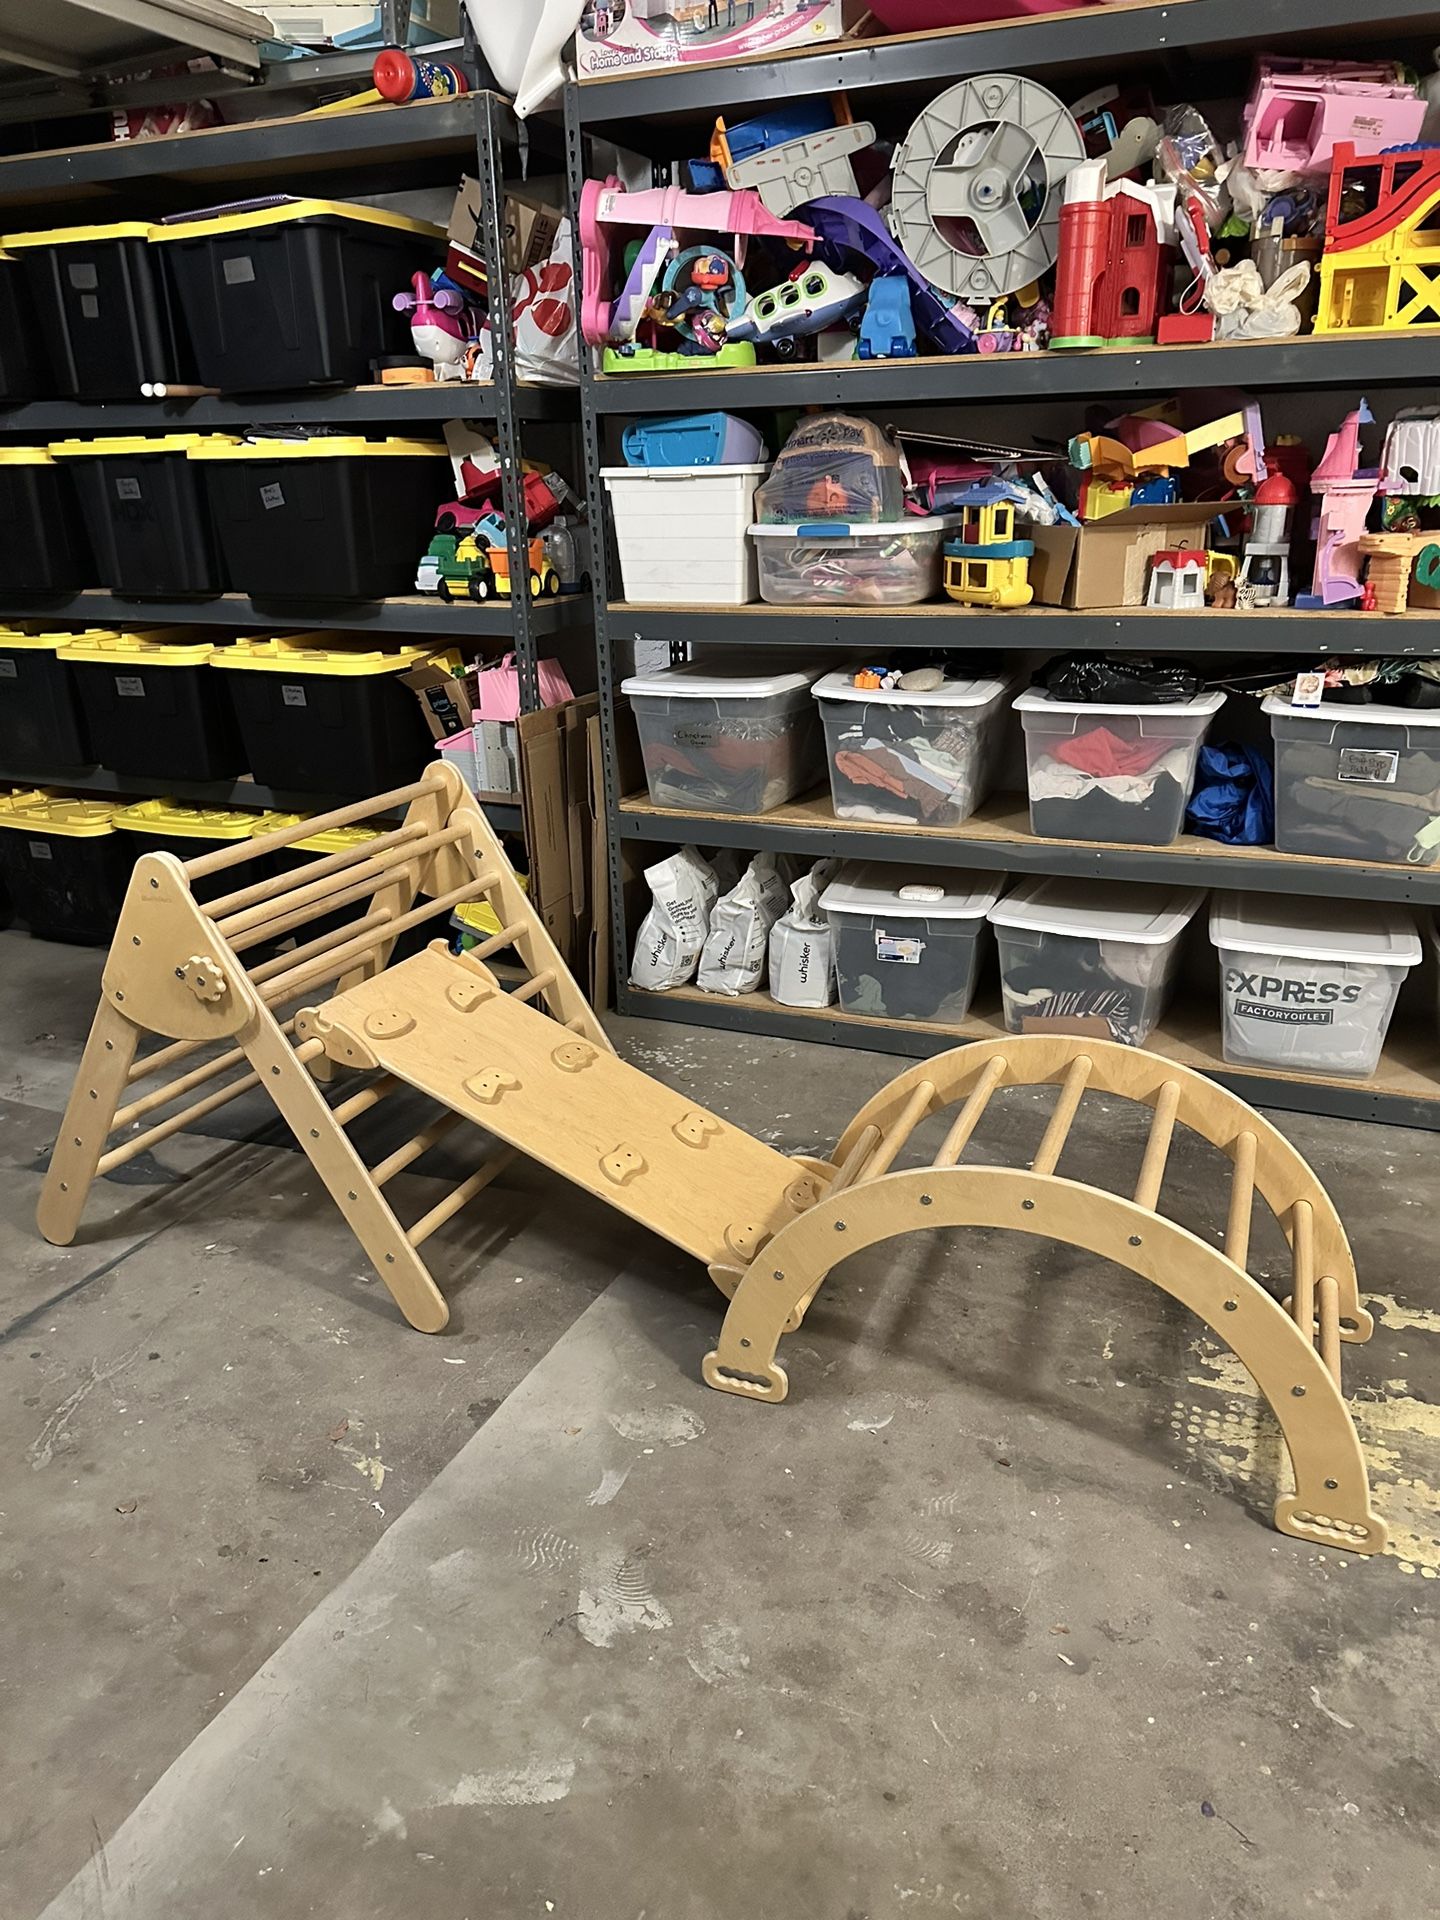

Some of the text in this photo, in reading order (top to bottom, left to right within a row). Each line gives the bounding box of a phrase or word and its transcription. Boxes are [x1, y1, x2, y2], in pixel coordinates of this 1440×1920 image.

[591, 54, 621, 70] Home
[621, 48, 642, 64] and
[643, 45, 679, 61] Stable
[843, 427, 864, 439] Pay
[650, 932, 667, 967] whiske
[798, 942, 811, 984] whisker
[1225, 968, 1362, 1003] EXPRESS
